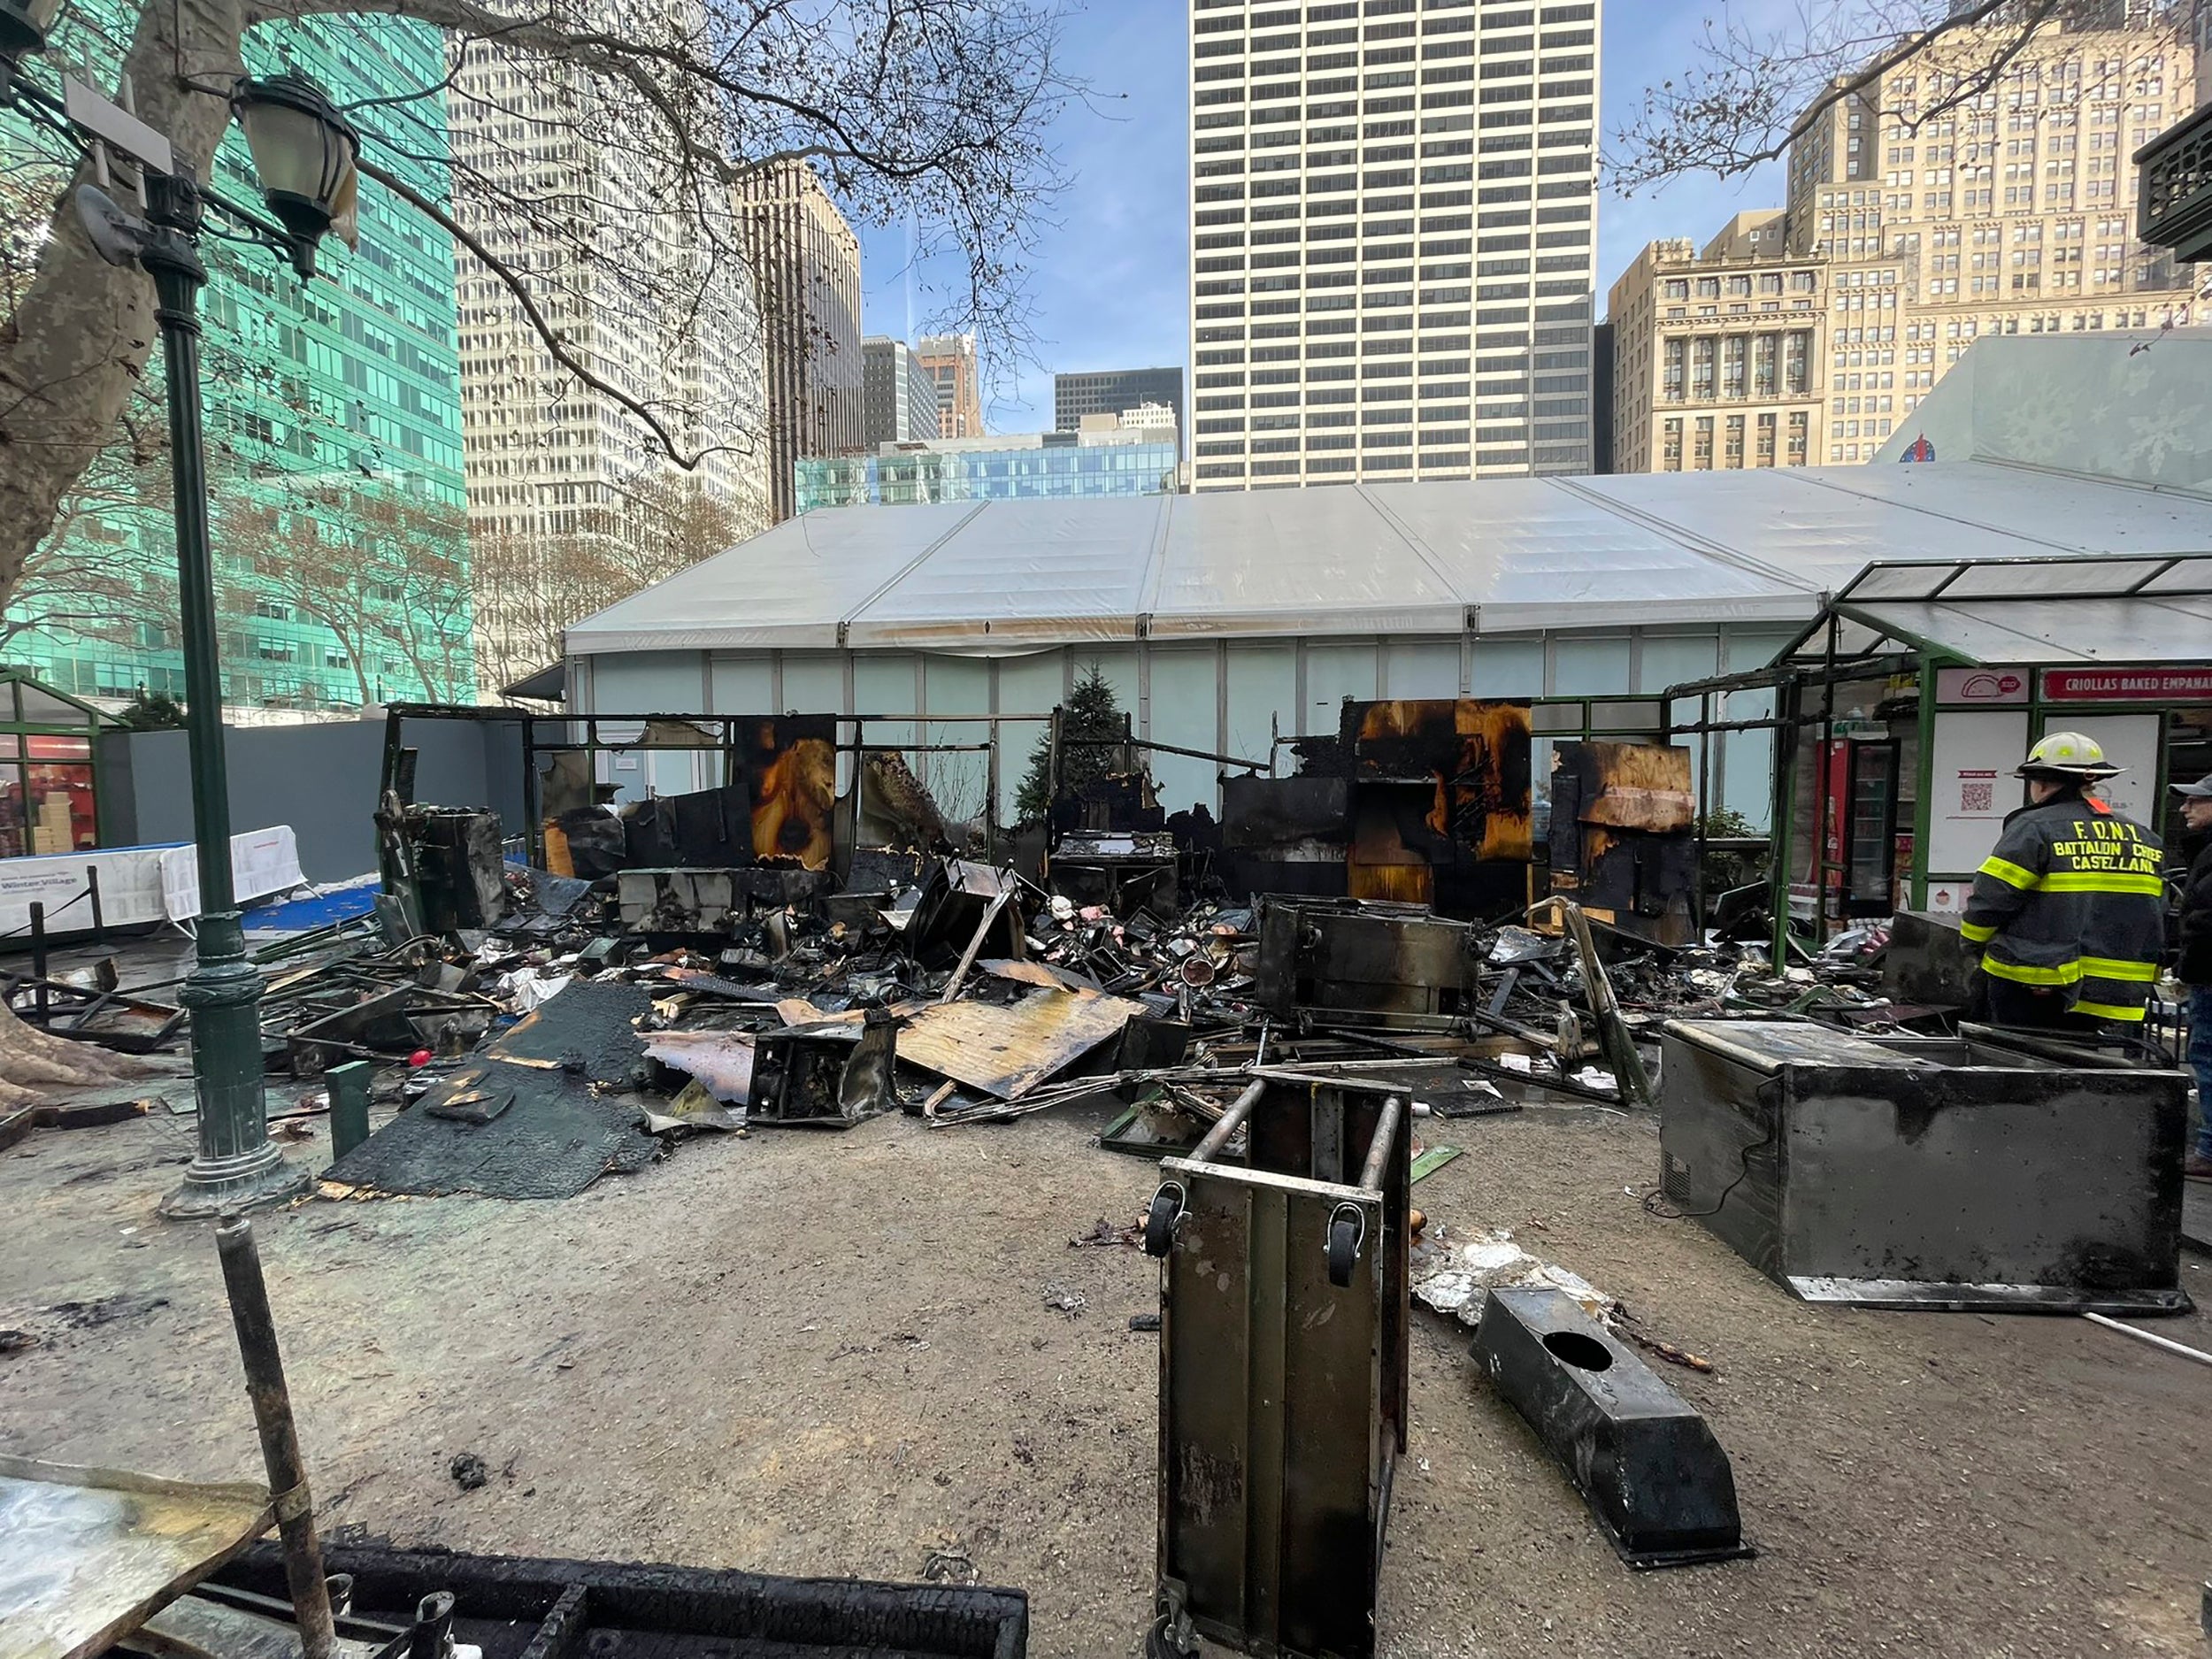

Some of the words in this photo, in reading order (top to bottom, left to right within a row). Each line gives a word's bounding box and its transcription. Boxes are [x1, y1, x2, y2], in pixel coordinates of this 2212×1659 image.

[2065, 678, 2117, 691] CRIOLLAS
[2121, 677, 2158, 690] BAKED
[2162, 677, 2212, 690] EMPANA
[2132, 843, 2163, 863] CHIEF
